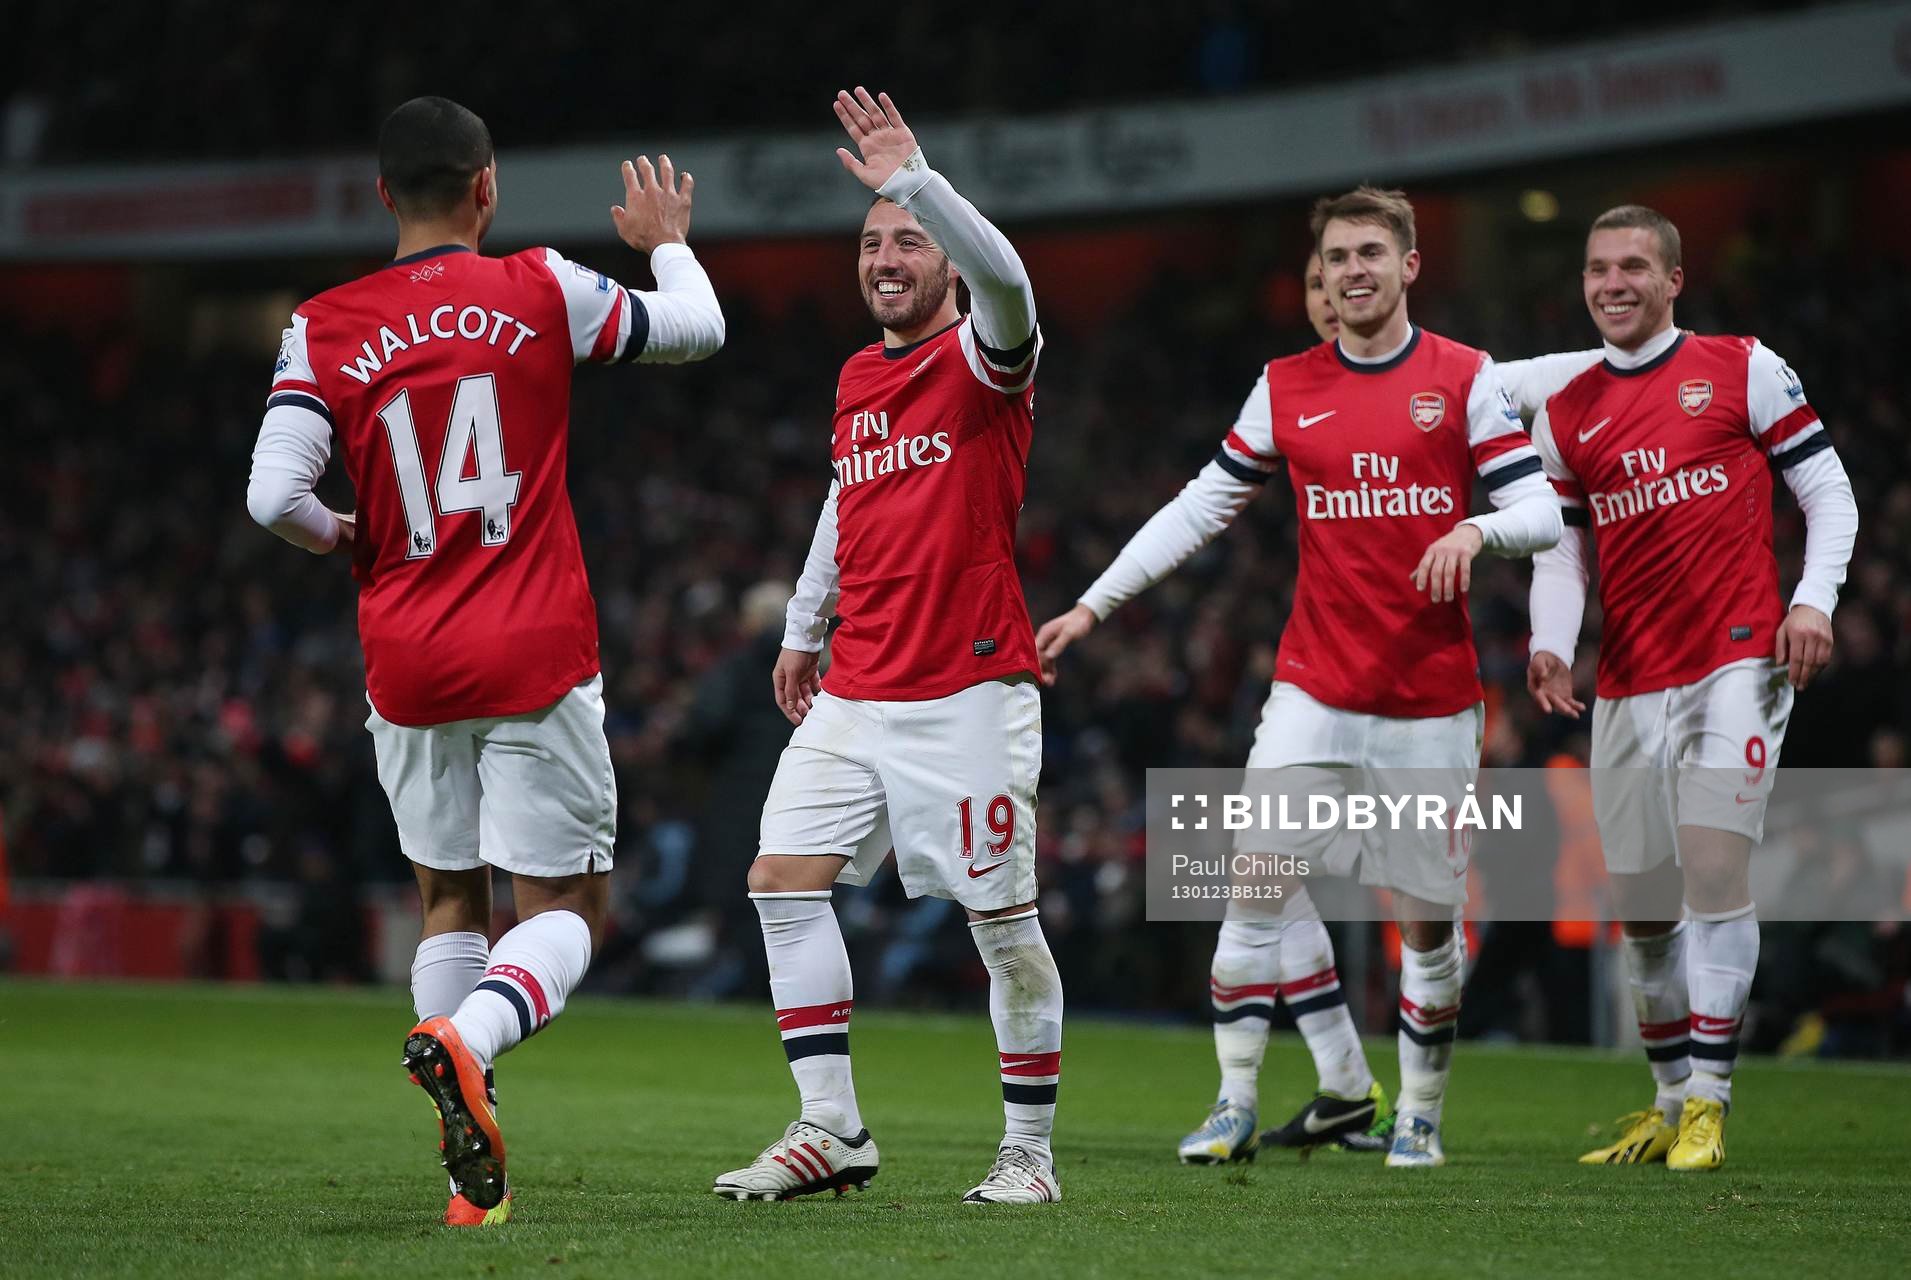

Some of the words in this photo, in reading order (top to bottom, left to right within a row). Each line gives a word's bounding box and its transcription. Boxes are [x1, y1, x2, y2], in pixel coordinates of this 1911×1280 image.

[339, 304, 537, 385] WALCOTT
[851, 410, 889, 441] Fly
[376, 372, 522, 560] 14
[836, 431, 952, 489] mirates
[1351, 452, 1399, 483] Fly
[1621, 447, 1666, 478] Fly
[1304, 481, 1454, 520] Emirates
[1588, 463, 1729, 527] Emirates
[1744, 735, 1766, 786] 9
[957, 793, 1016, 859] 19
